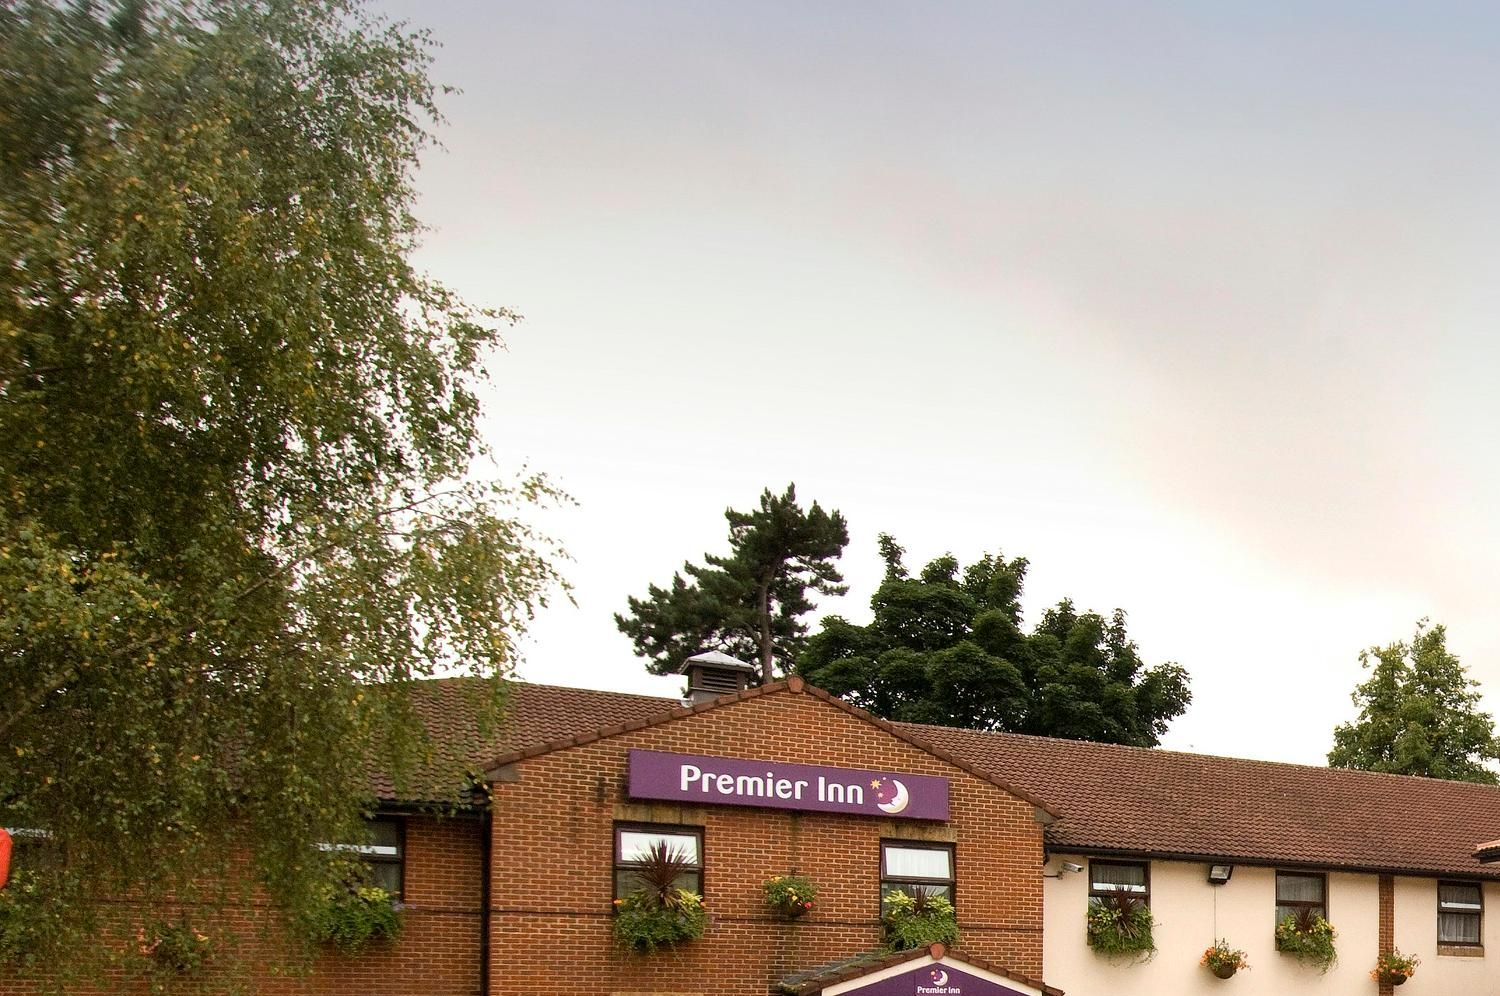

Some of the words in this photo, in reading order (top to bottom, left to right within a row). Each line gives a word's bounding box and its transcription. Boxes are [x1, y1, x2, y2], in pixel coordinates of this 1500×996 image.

[680, 765, 809, 800] Premier
[818, 776, 864, 805] Inn
[917, 986, 947, 994] Premier
[948, 986, 961, 994] Inn
